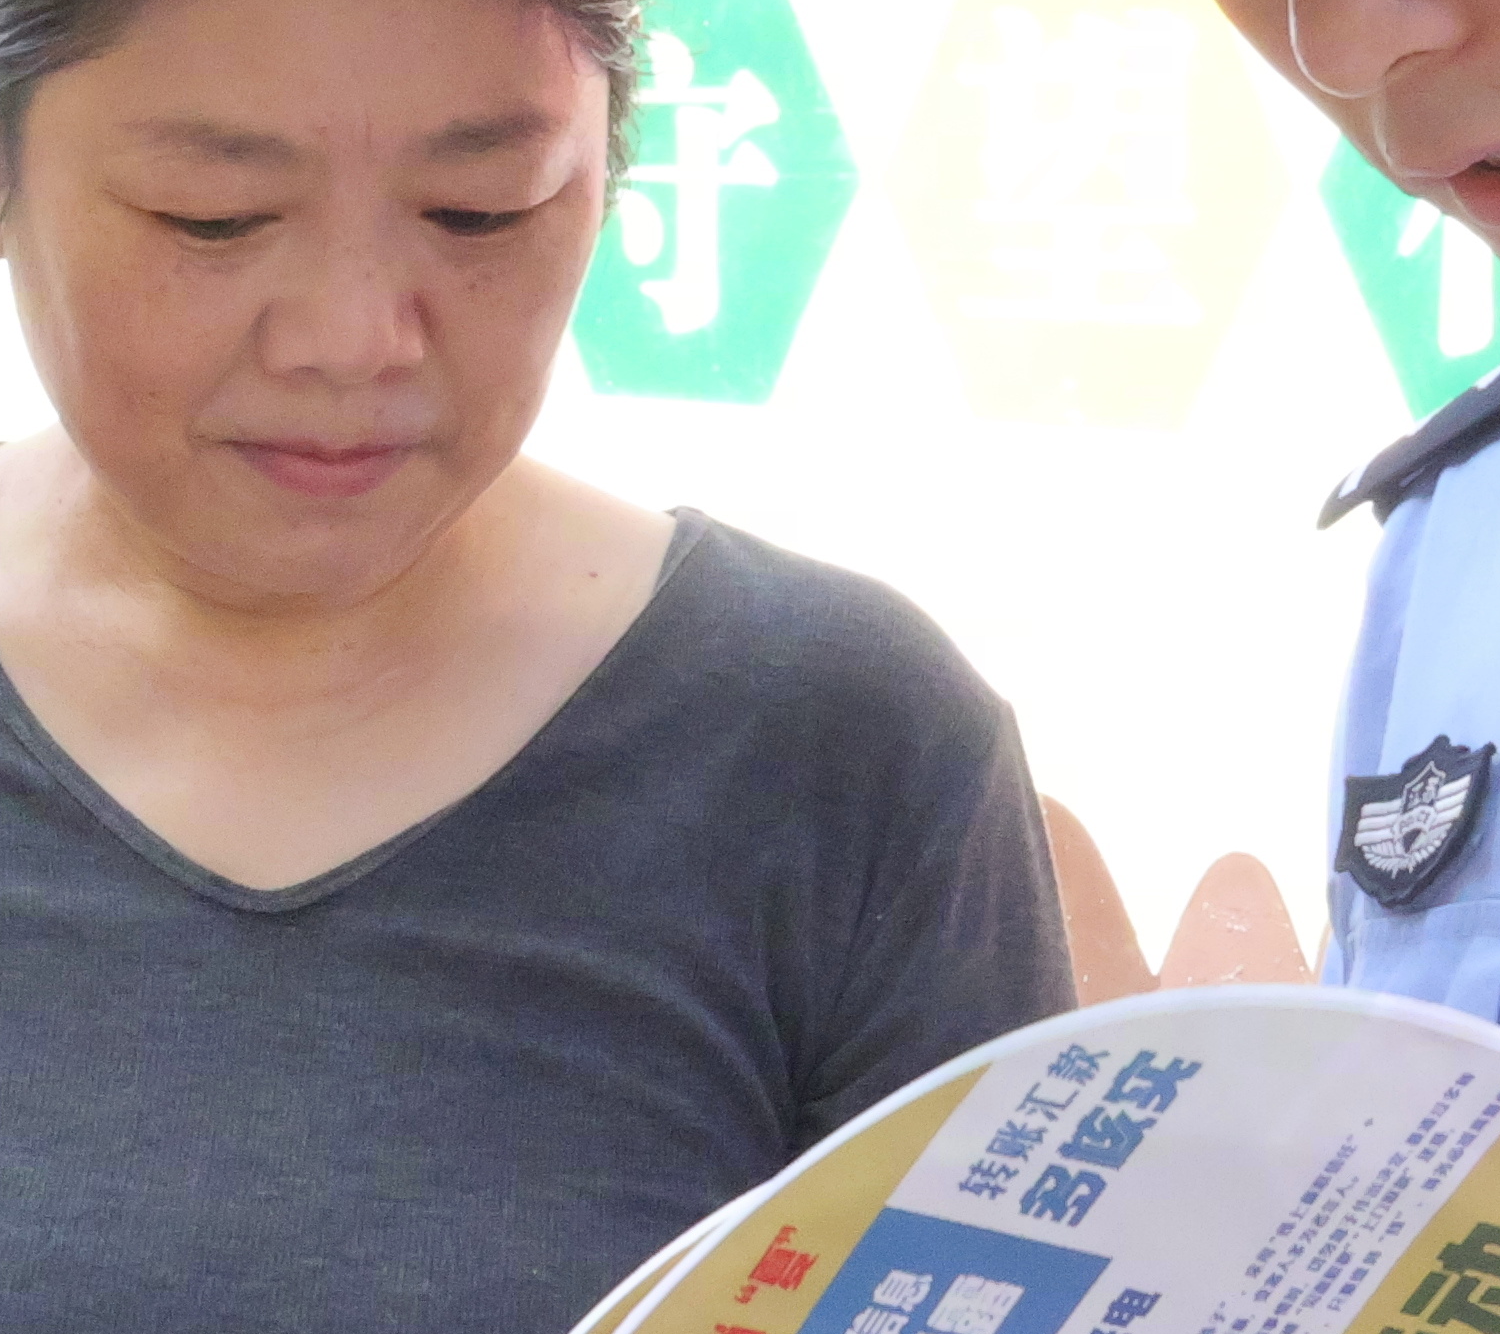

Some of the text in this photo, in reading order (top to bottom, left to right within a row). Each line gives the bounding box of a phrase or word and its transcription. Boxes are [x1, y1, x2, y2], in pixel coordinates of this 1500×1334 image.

[953, 1039, 1112, 1202] 转账汇款
[1011, 1045, 1203, 1227] 多核实
